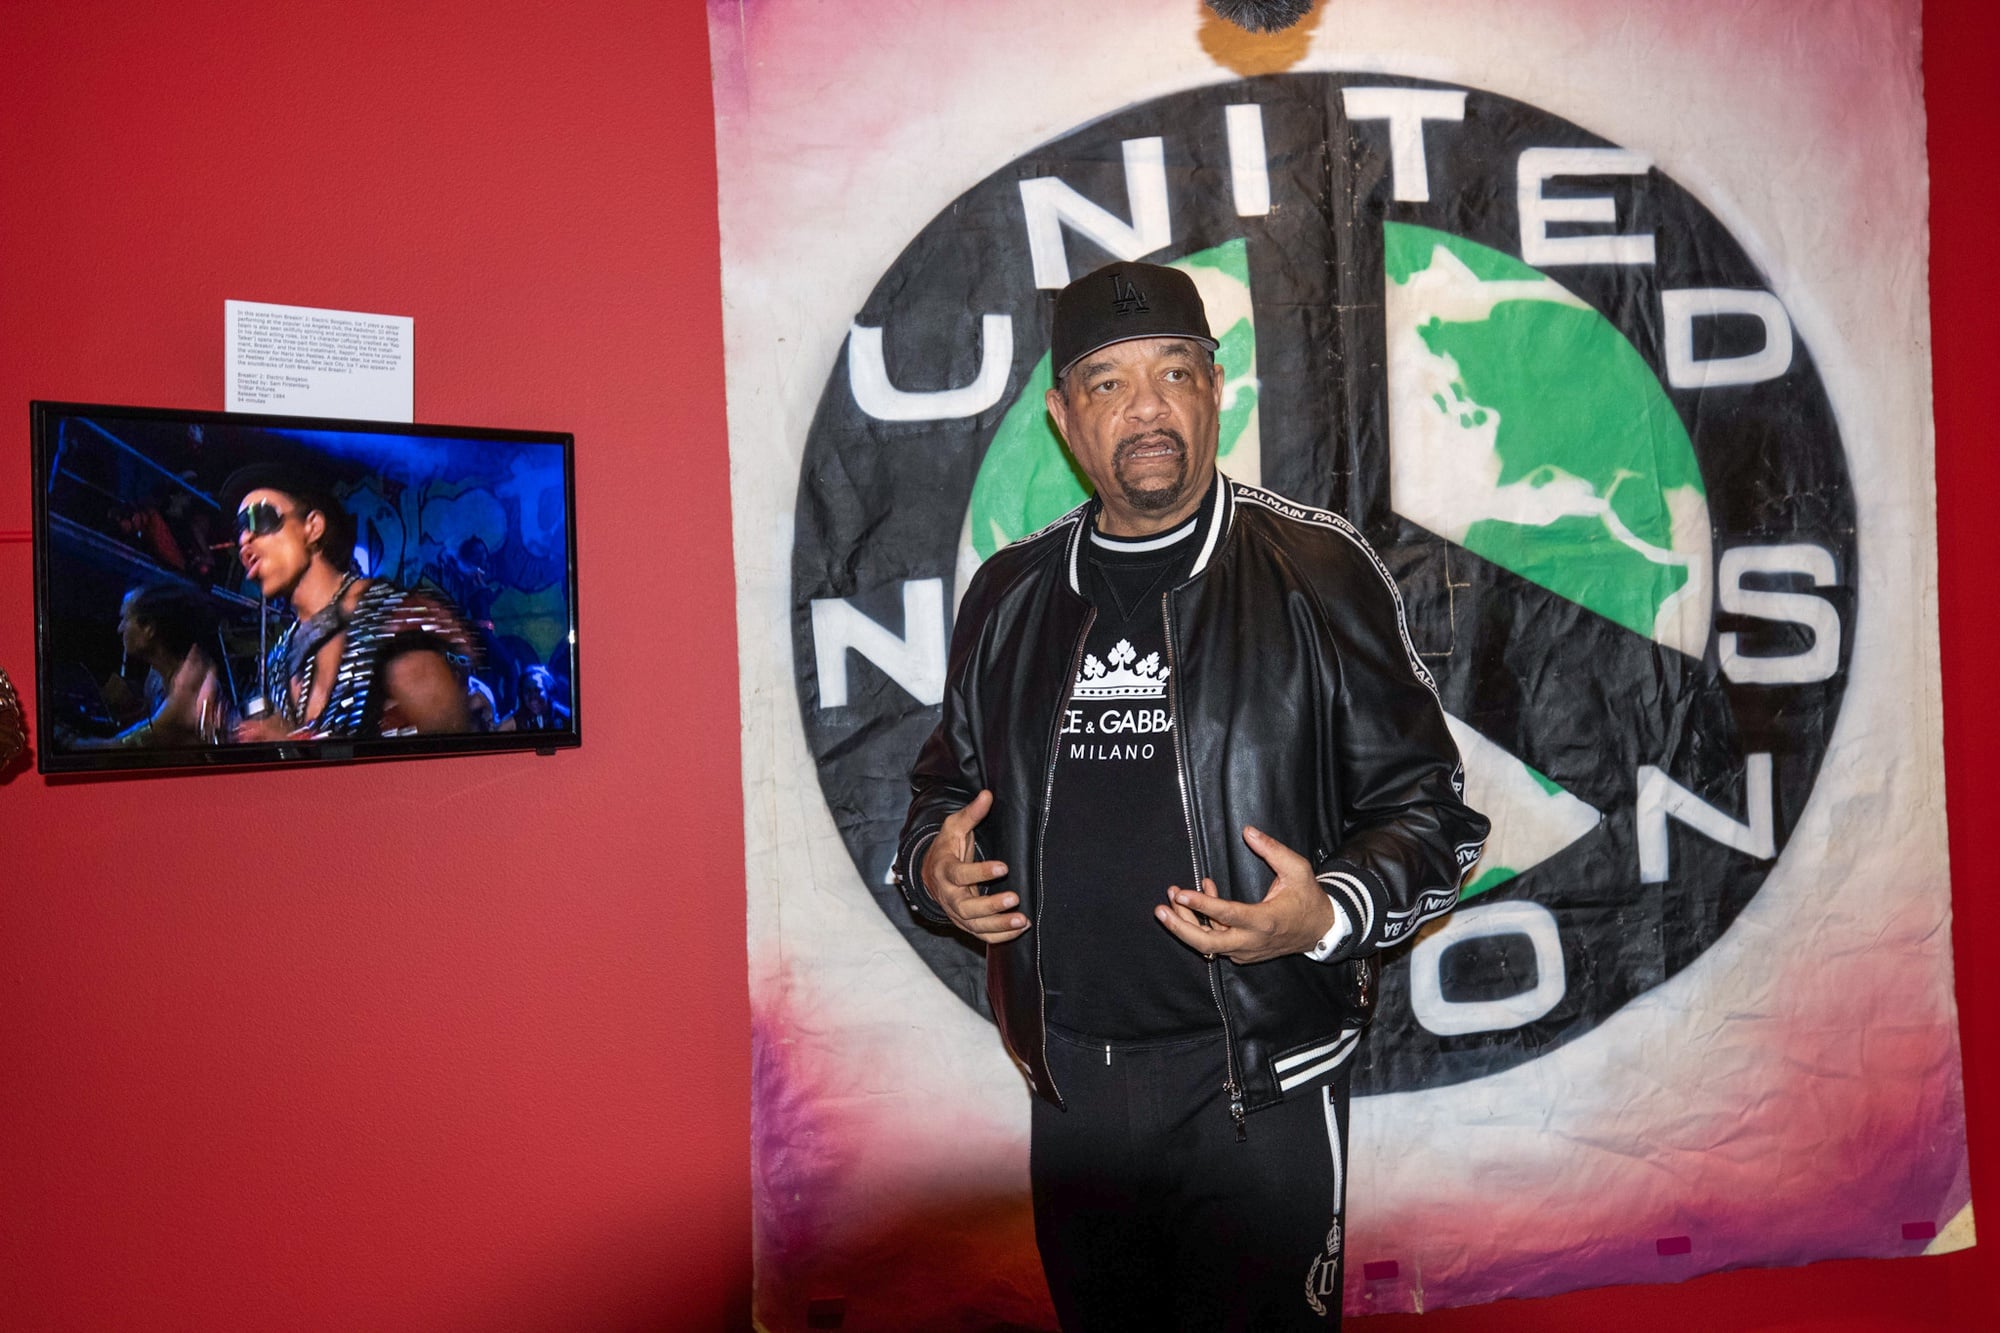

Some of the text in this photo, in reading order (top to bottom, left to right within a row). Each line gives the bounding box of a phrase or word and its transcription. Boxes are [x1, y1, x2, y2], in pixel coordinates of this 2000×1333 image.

[849, 87, 1794, 421] UNITED
[1107, 273, 1150, 316] LA
[1237, 487, 1306, 519] BALMAIN
[1312, 512, 1355, 534] PARIS
[1085, 721, 1095, 734] &
[1070, 743, 1155, 760] MILANO
